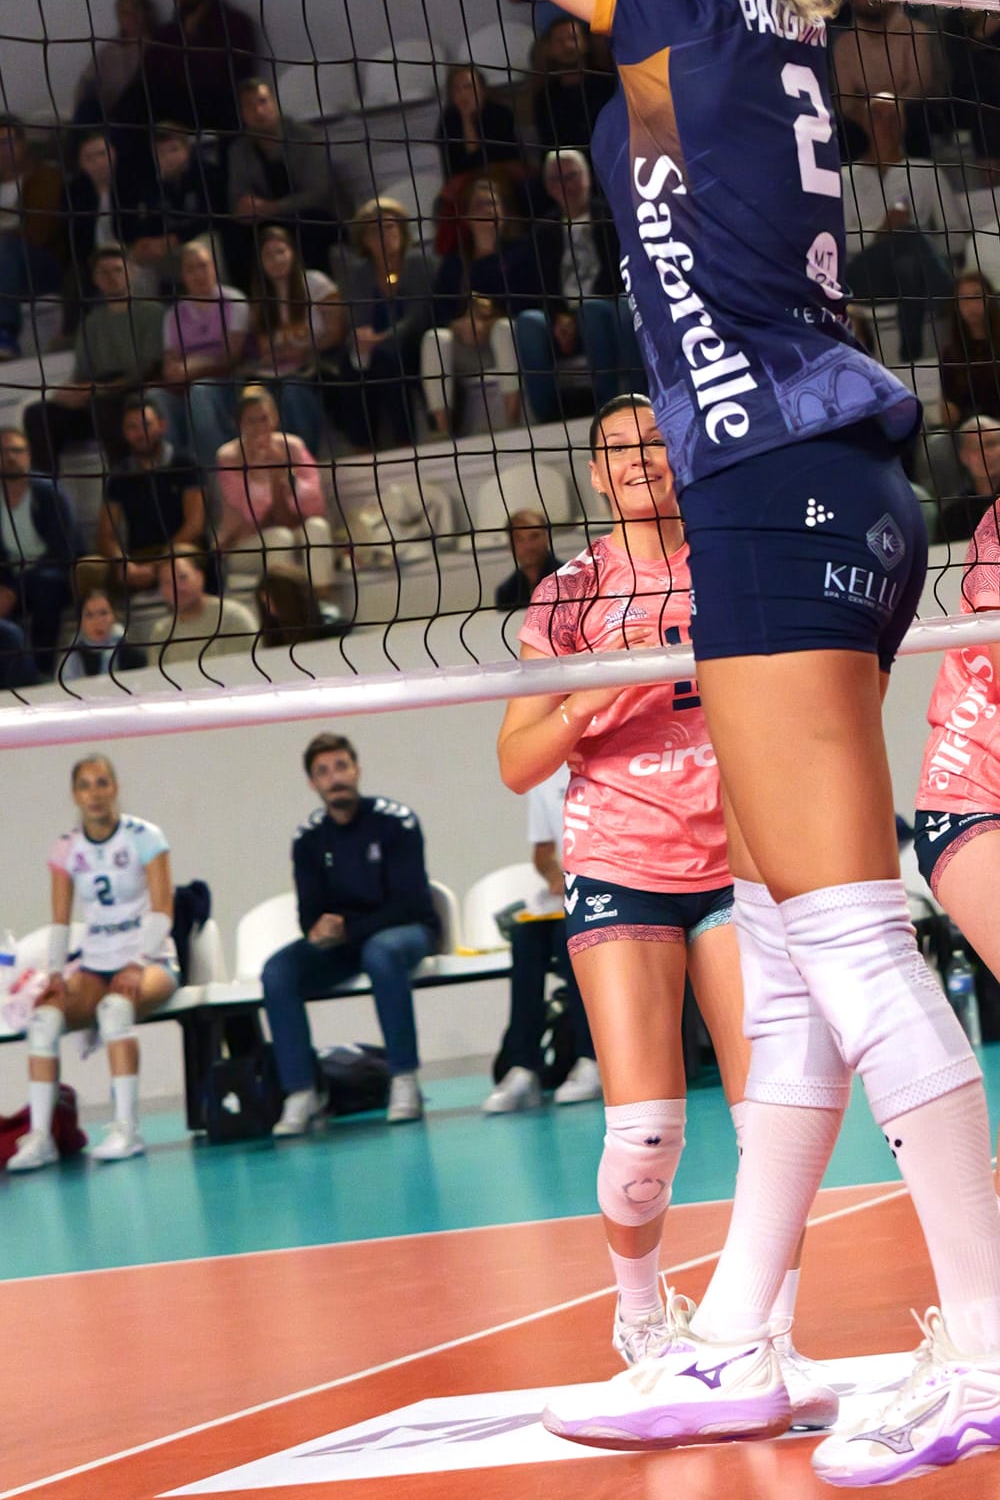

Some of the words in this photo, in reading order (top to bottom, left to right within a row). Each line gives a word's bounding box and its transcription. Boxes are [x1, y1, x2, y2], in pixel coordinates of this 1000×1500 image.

[781, 62, 842, 198] 2
[633, 154, 760, 445] Saforelle
[628, 741, 718, 777] circ
[94, 874, 115, 907] 2
